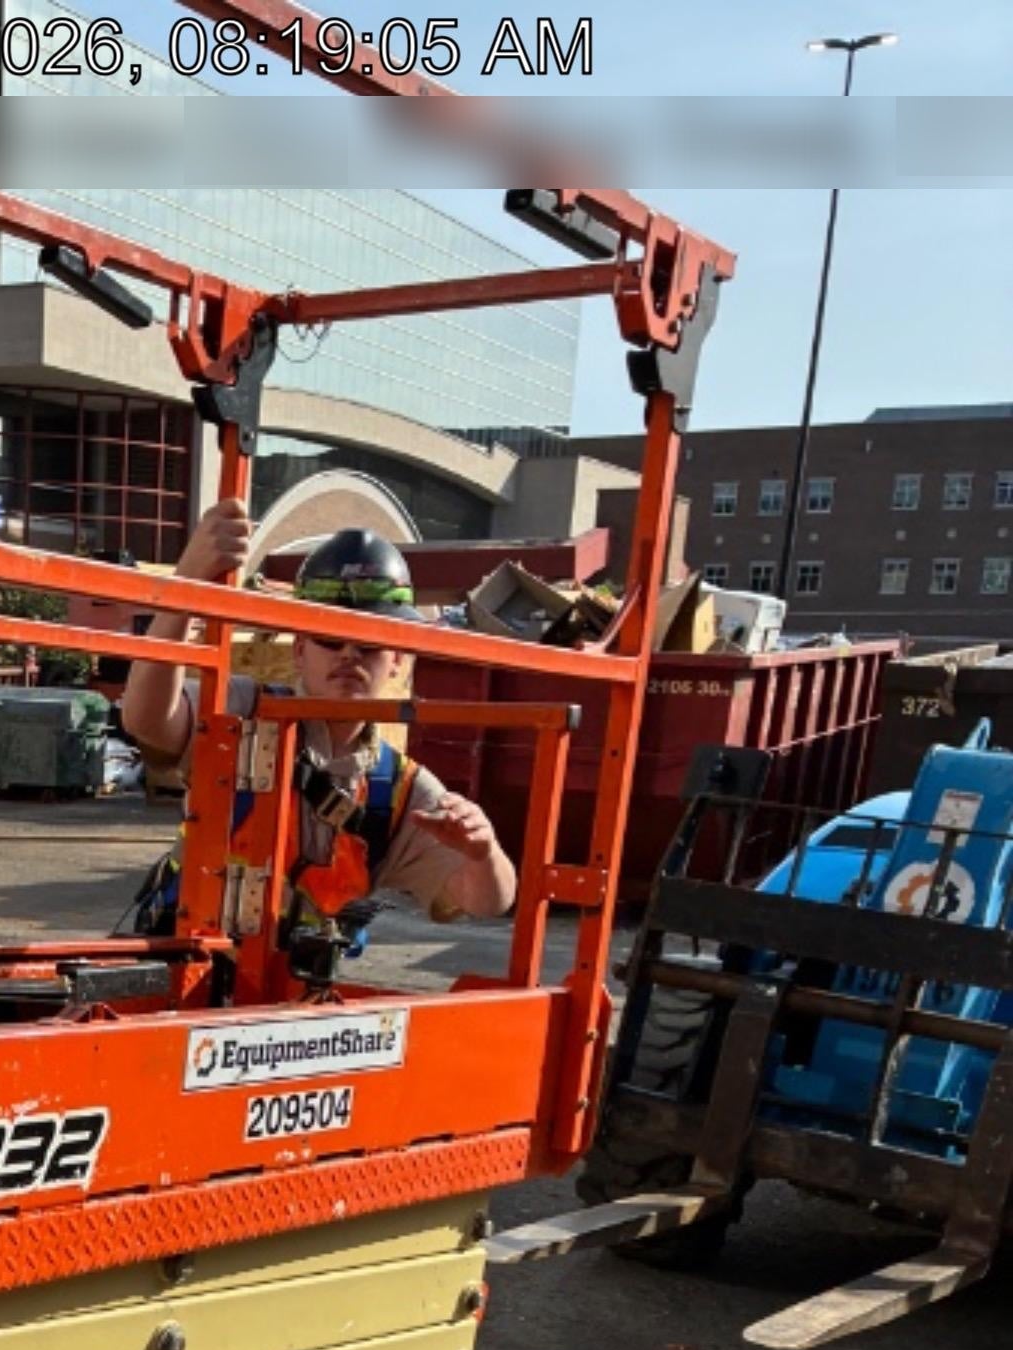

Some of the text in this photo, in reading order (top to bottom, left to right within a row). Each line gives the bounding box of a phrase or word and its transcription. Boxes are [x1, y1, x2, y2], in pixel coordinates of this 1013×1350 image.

[901, 696, 940, 718] 372
[221, 1027, 396, 1073] EquipmentShare
[246, 1088, 351, 1138] 209504
